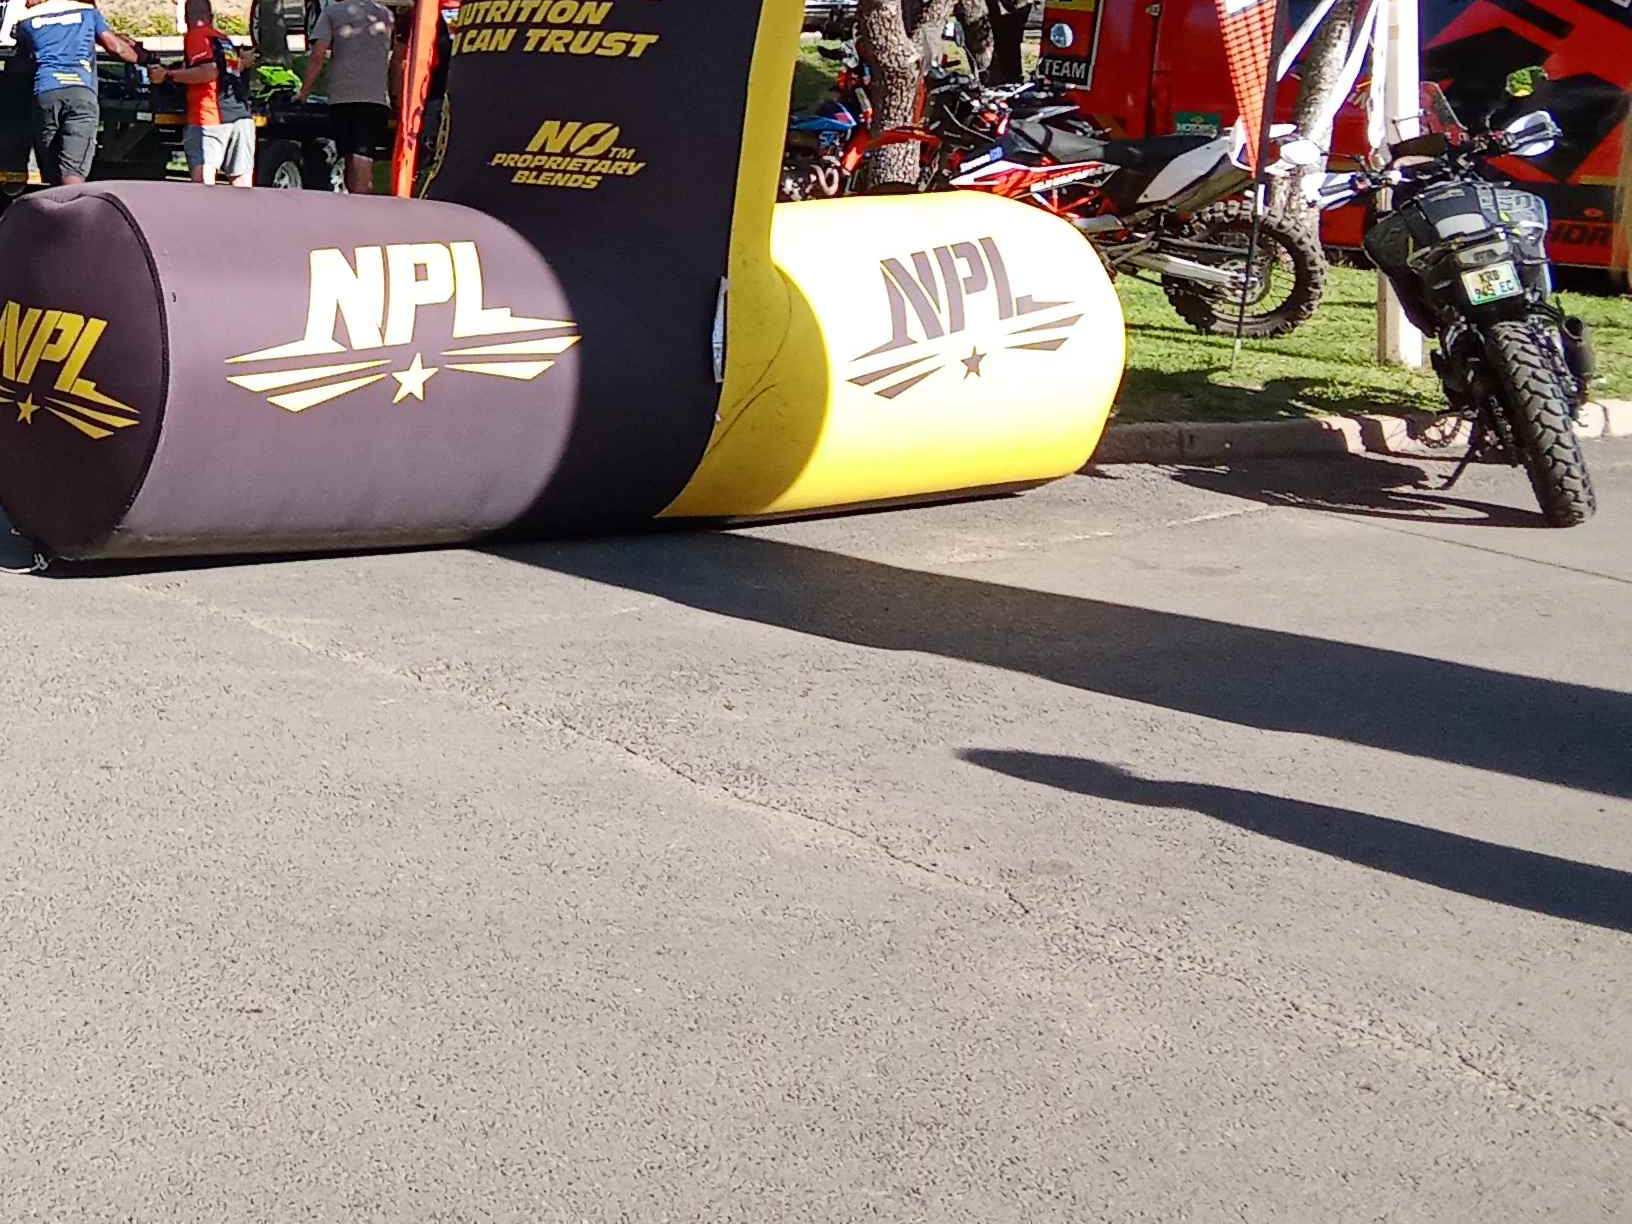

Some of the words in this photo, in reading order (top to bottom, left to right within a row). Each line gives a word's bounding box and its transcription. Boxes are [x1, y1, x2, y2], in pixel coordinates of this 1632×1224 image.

[460, 0, 613, 26] UTRITION
[462, 28, 518, 53] CAN
[523, 29, 659, 58] TRUST
[1044, 59, 1087, 80] TEAM
[525, 120, 620, 157] NO
[490, 153, 647, 176] PROPRIETARY
[510, 169, 603, 189] BLENDS
[224, 240, 578, 364] NPL
[848, 237, 1074, 362] NPL
